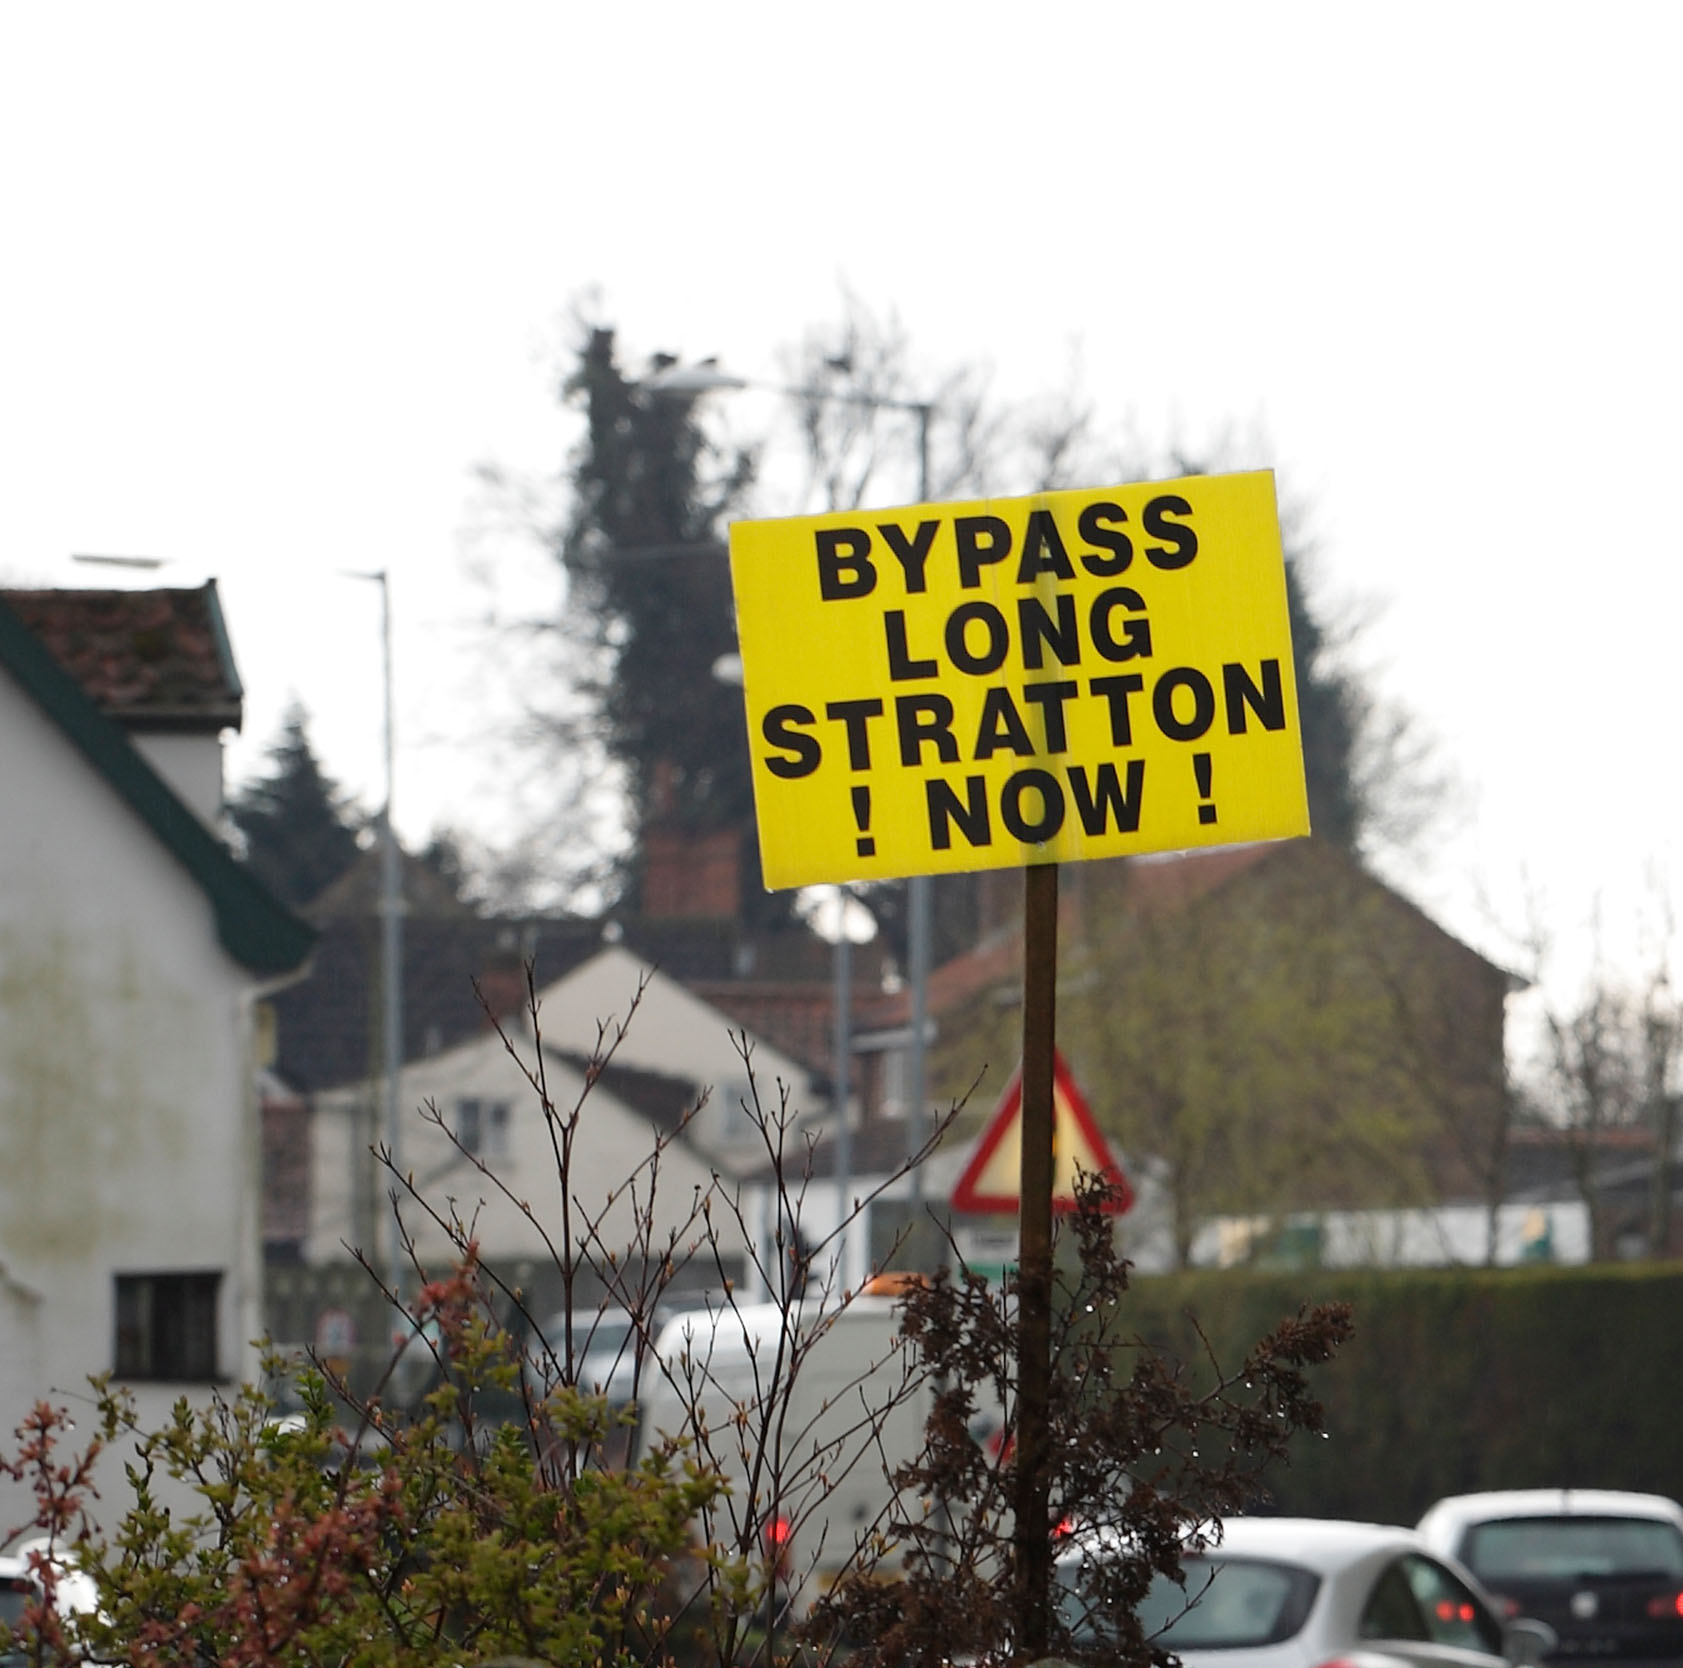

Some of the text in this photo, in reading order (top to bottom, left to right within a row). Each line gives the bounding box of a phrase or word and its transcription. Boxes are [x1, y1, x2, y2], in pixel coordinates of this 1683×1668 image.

[815, 495, 1199, 602] BYPASS
[884, 586, 1153, 681] LONG
[761, 658, 1287, 779] STRATTON
[850, 752, 1219, 857] ! NOW !
